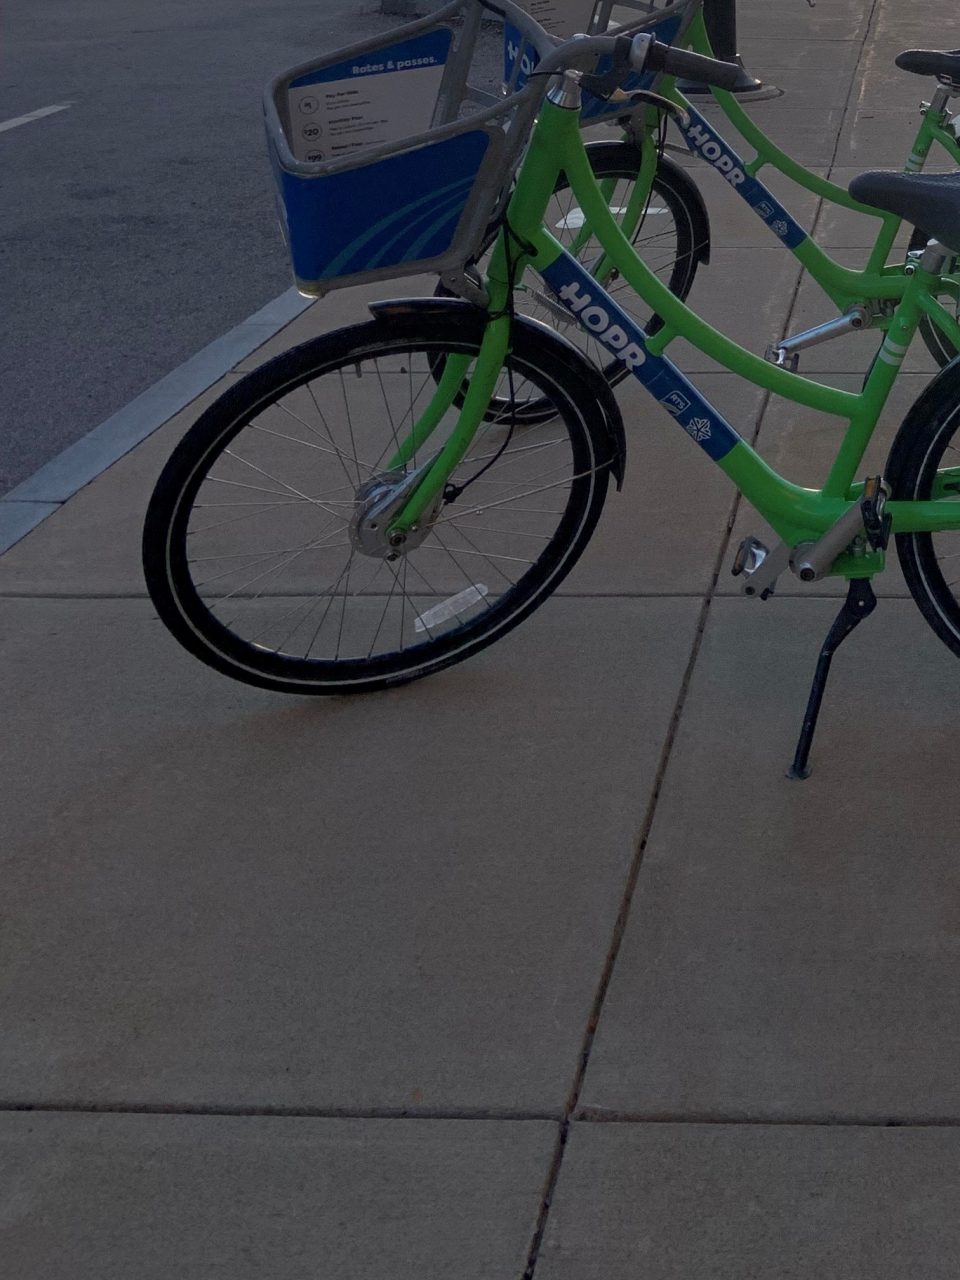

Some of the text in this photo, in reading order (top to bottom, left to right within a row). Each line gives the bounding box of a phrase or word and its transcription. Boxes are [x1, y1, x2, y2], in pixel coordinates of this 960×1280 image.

[352, 55, 437, 74] Rates & passes.
[507, 40, 534, 76] HO
[687, 124, 745, 188] HOPR
[559, 282, 646, 371] HOPR
